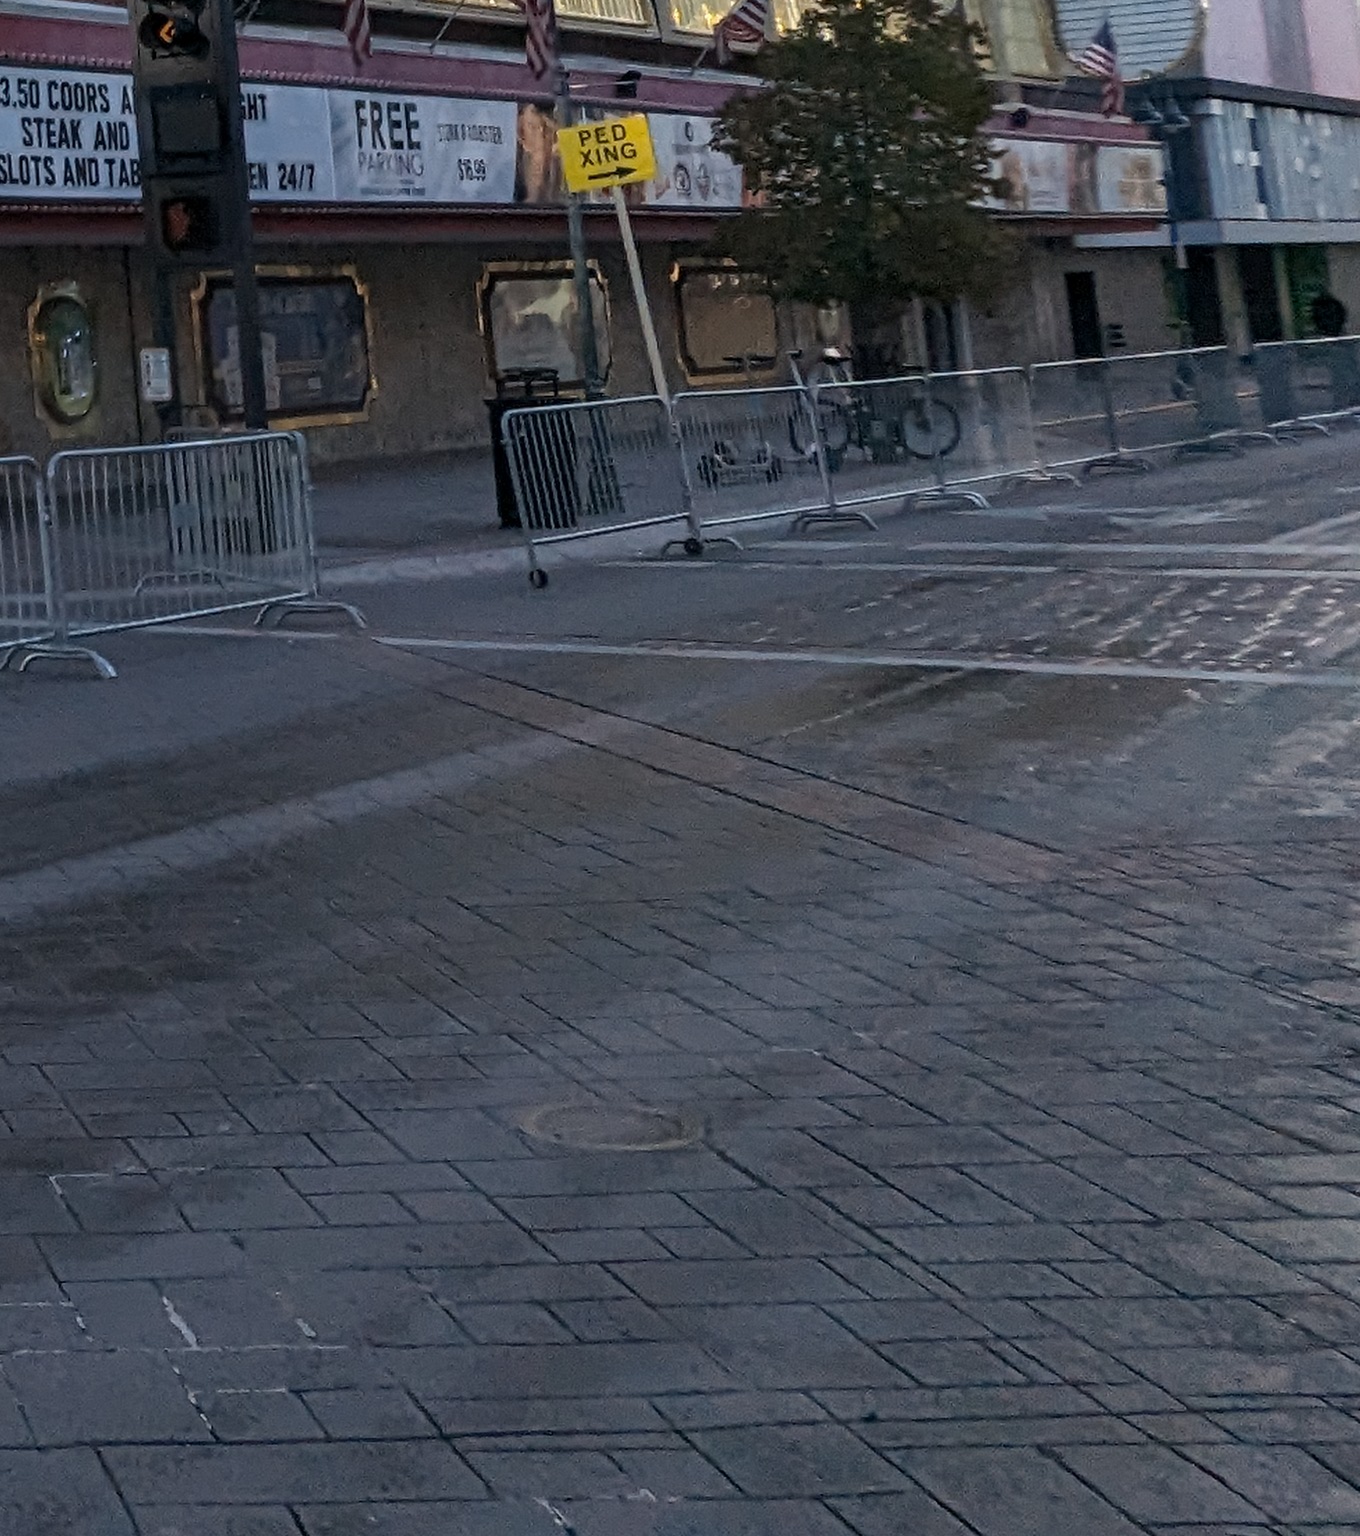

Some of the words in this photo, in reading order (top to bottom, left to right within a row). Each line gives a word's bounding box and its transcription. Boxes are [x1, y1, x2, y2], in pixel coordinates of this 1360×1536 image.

[47, 79, 111, 113] COORS
[20, 116, 83, 150] STEAK
[93, 120, 131, 151] AND
[354, 99, 422, 151] FREE
[578, 124, 626, 148] PED
[357, 150, 425, 177] PARKING
[579, 142, 637, 169] XING
[63, 157, 100, 187] AND
[277, 162, 316, 191] 24/7
